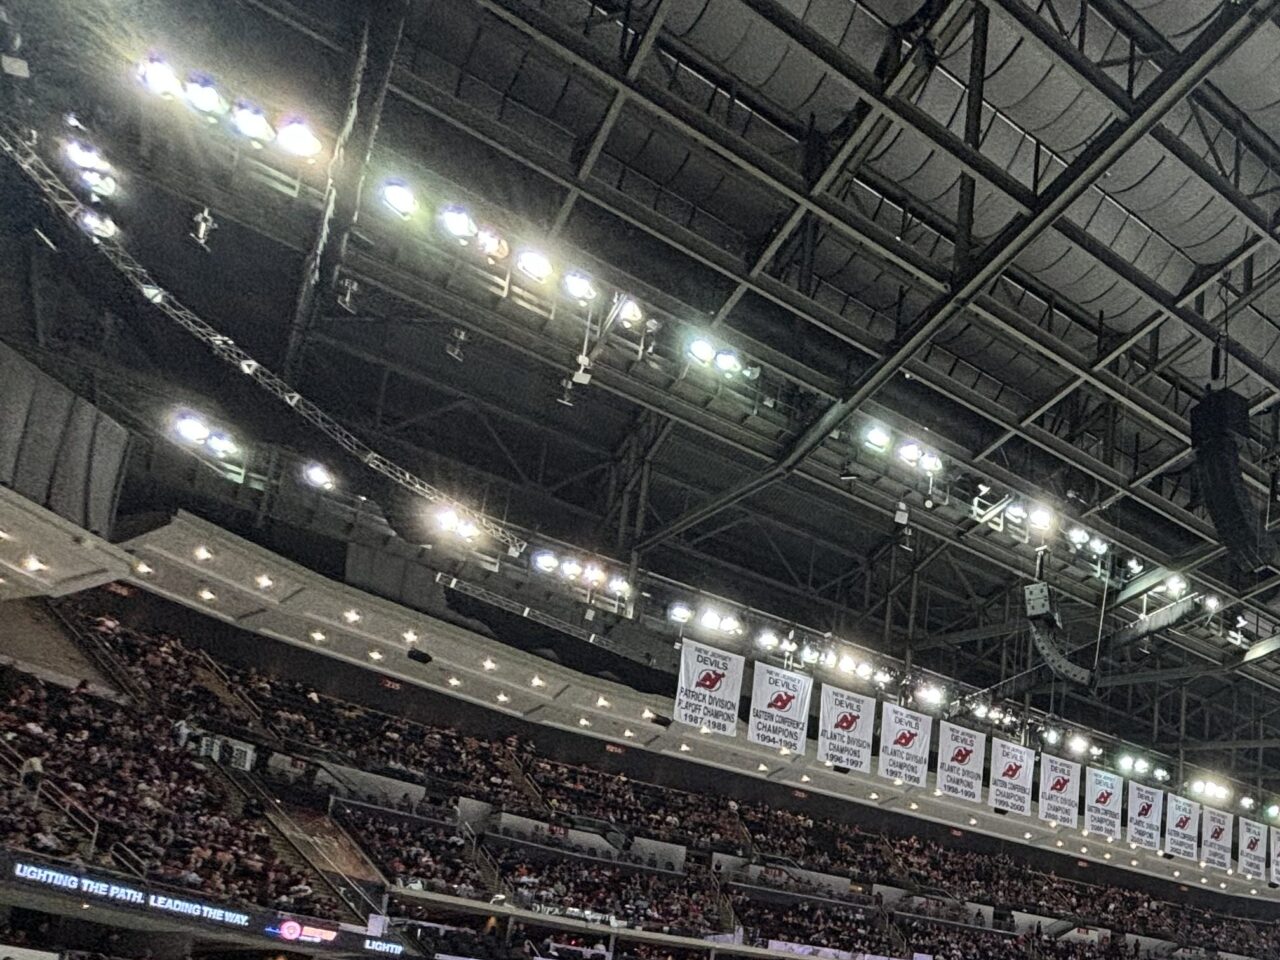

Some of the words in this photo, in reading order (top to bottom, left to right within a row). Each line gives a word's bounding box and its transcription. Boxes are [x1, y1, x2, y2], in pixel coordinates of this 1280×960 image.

[696, 654, 728, 671] DEVILS
[769, 677, 797, 692] DEVILS
[680, 686, 707, 702] PATRICK
[707, 695, 736, 711] DIVISION
[834, 699, 861, 712] DEVILS
[702, 706, 735, 723] CHAMPIONS
[757, 722, 798, 740] CHAMPIONS
[951, 734, 974, 747] DEVILS
[829, 743, 860, 758] CHAMPIONS
[15, 864, 78, 889] LIGHTING
[81, 879, 108, 895] THE
[109, 885, 145, 903] PATH.
[150, 896, 201, 917] LEADING
[202, 906, 229, 921] THE
[225, 911, 249, 926] WAY.
